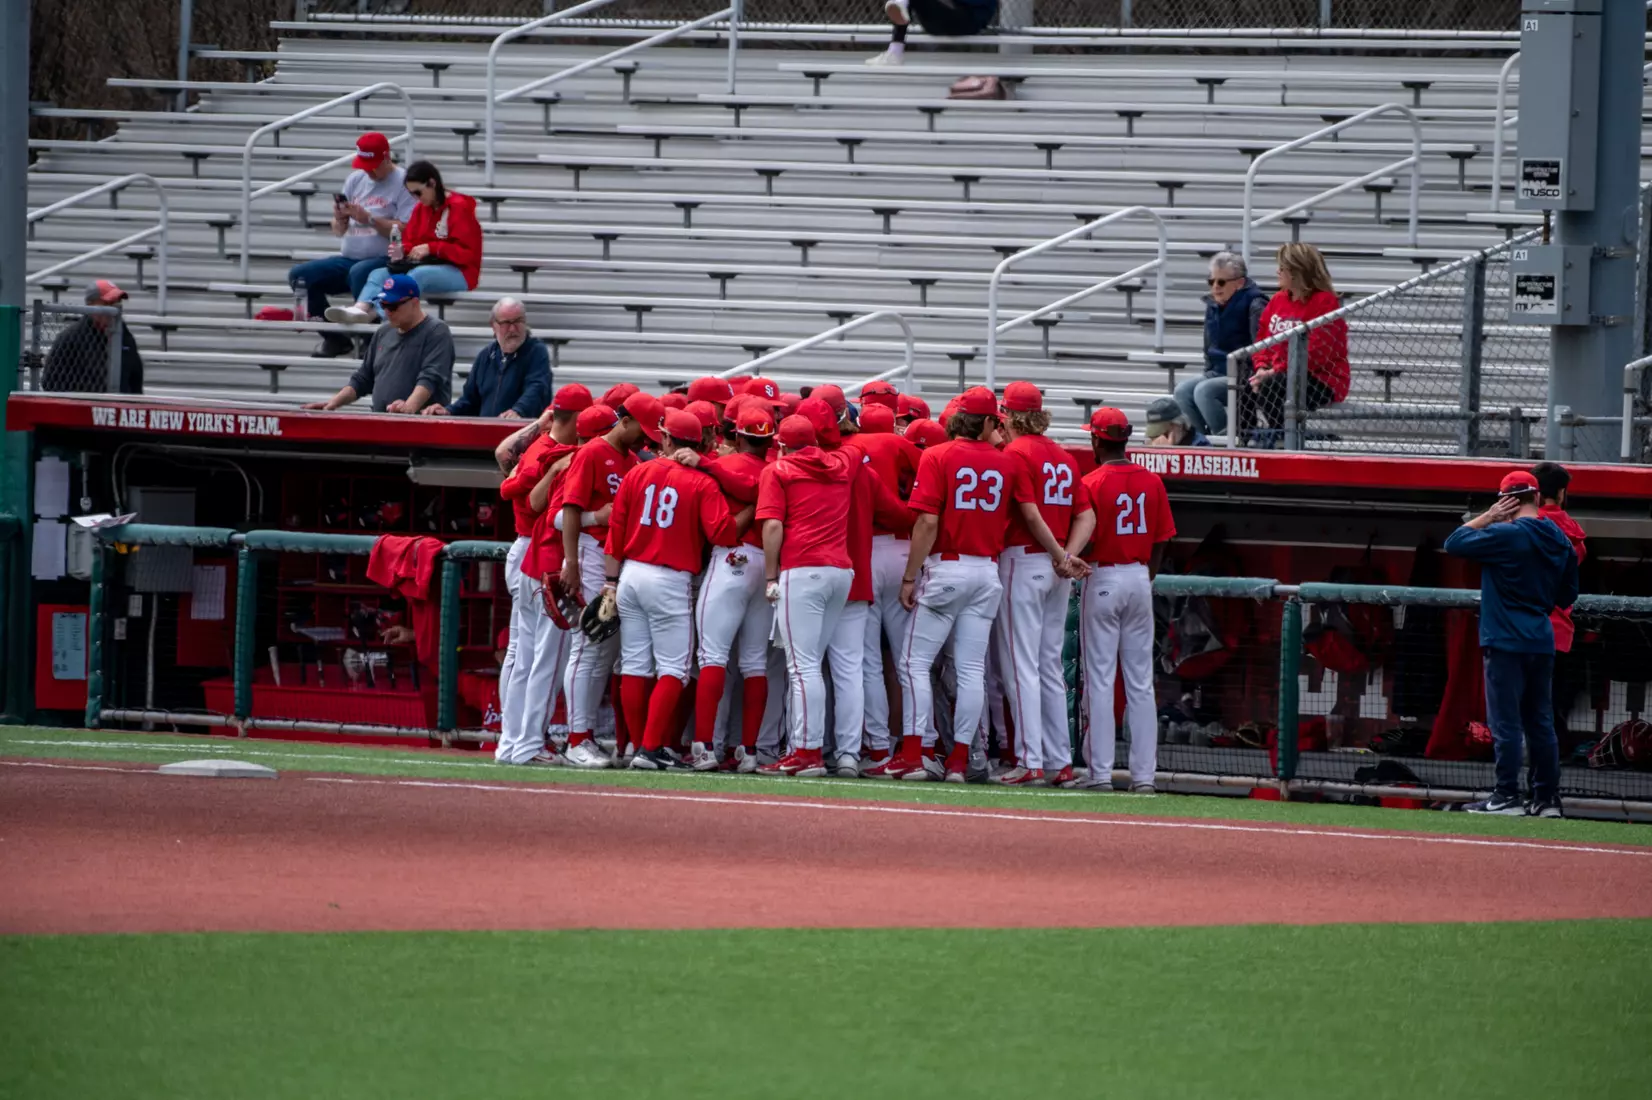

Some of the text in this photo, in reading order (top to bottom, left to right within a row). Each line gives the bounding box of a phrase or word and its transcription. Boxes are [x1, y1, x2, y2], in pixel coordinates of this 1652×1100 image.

[1525, 20, 1538, 31] A1
[1515, 251, 1526, 260] A1
[92, 406, 283, 436] WE ARE NEW YORK'S TEAM.
[1042, 462, 1074, 506] 22
[1184, 455, 1259, 478] BASEBALL
[639, 483, 679, 529] 18
[954, 467, 1005, 512] 23
[1115, 492, 1148, 536] 21
